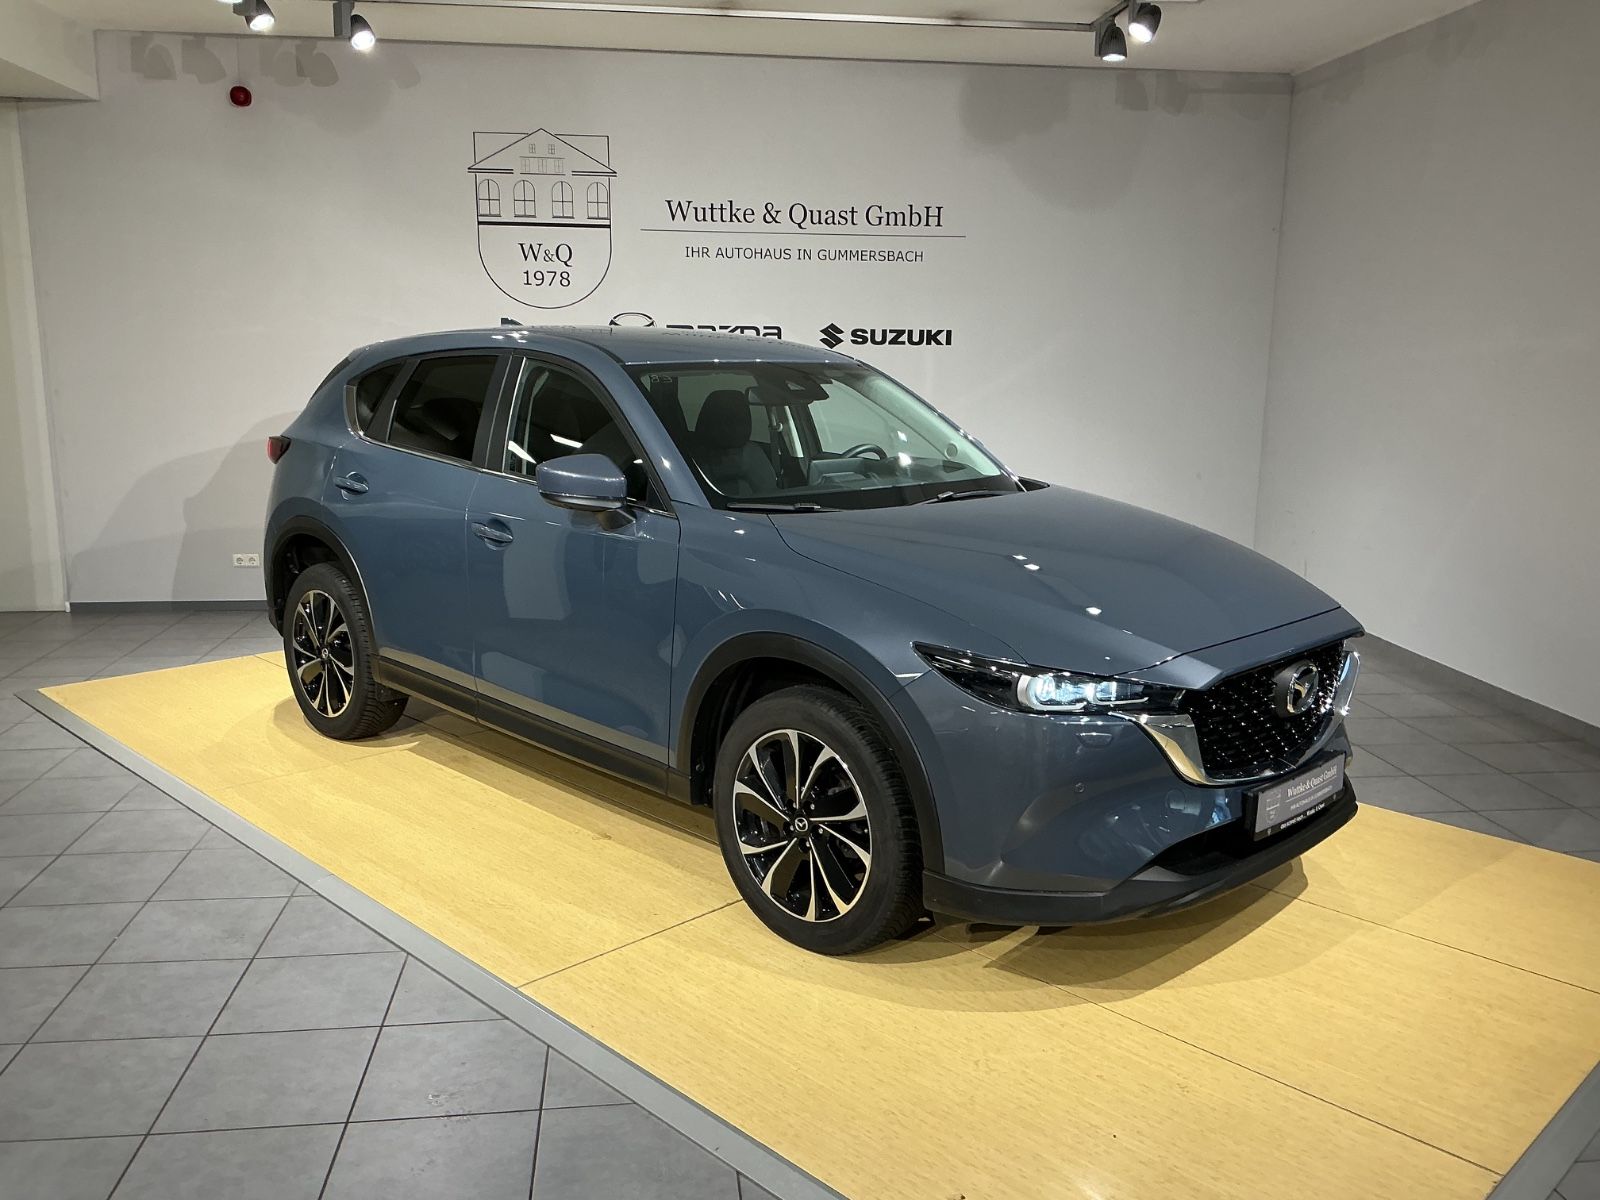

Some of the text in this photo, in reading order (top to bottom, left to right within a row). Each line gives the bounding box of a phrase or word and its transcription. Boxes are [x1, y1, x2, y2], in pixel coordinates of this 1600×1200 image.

[665, 199, 944, 230] Wuttke & Quast GmbH
[517, 242, 573, 268] W&Q
[685, 246, 924, 263] IHR AUTOHAUS IN GUMMERSBACH
[522, 269, 571, 288] 1978
[850, 327, 953, 346] SUZUKI
